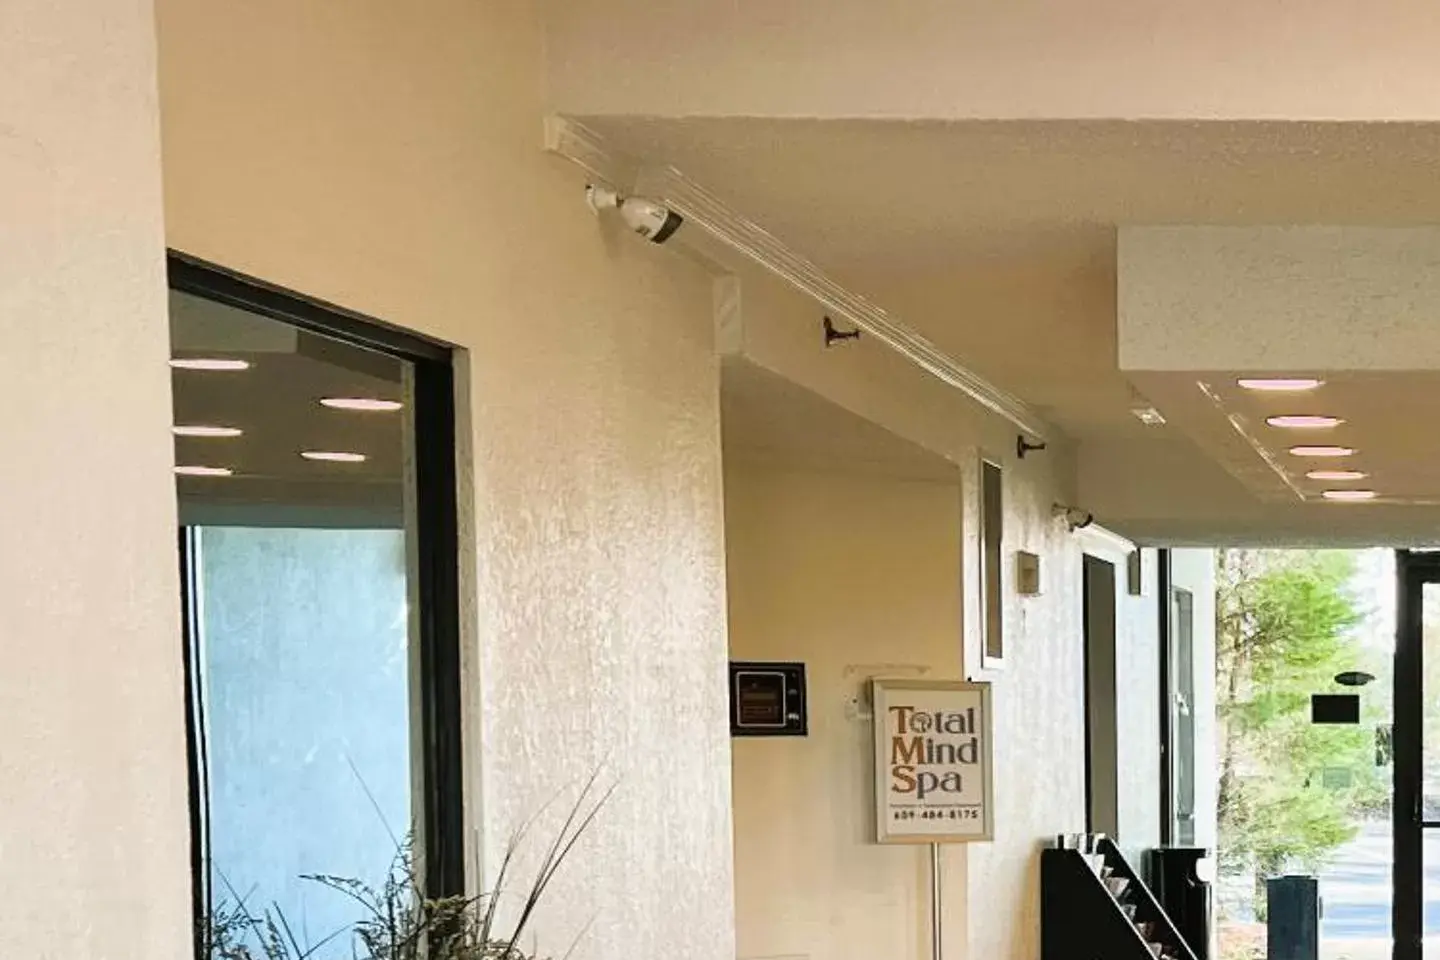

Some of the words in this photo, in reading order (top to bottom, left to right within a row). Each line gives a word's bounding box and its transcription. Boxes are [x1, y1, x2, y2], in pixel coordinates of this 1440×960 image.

[888, 706, 976, 734] Total
[890, 736, 978, 765] Mind
[891, 765, 962, 800] Spa
